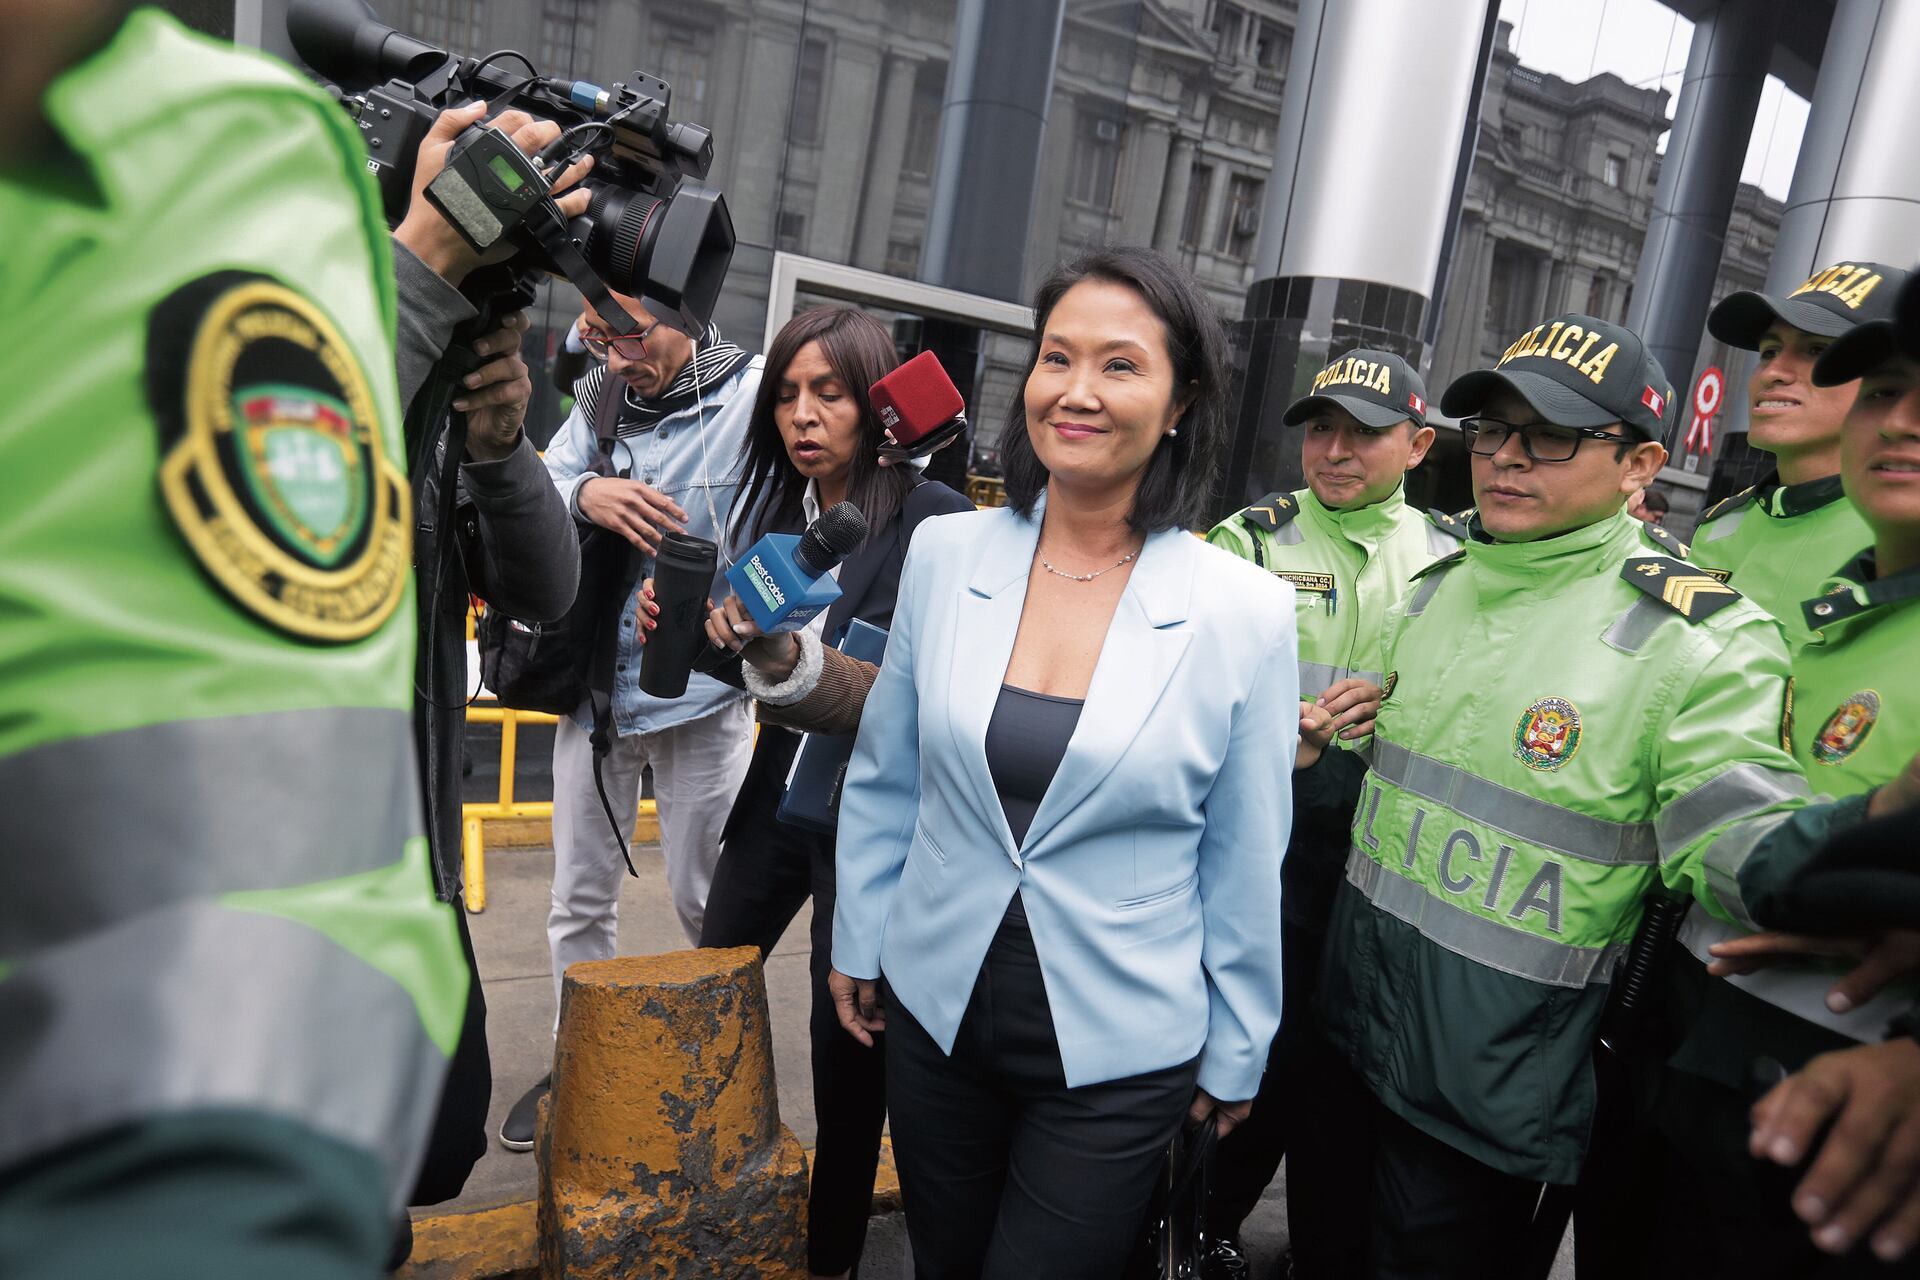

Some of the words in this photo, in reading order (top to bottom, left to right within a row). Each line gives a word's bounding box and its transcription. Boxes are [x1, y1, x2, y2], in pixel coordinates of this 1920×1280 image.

[1309, 357, 1391, 396] POLICIA
[1493, 321, 1619, 384] POLICIA
[749, 572, 771, 602] Noticias
[1352, 780, 1563, 935] LICIA
